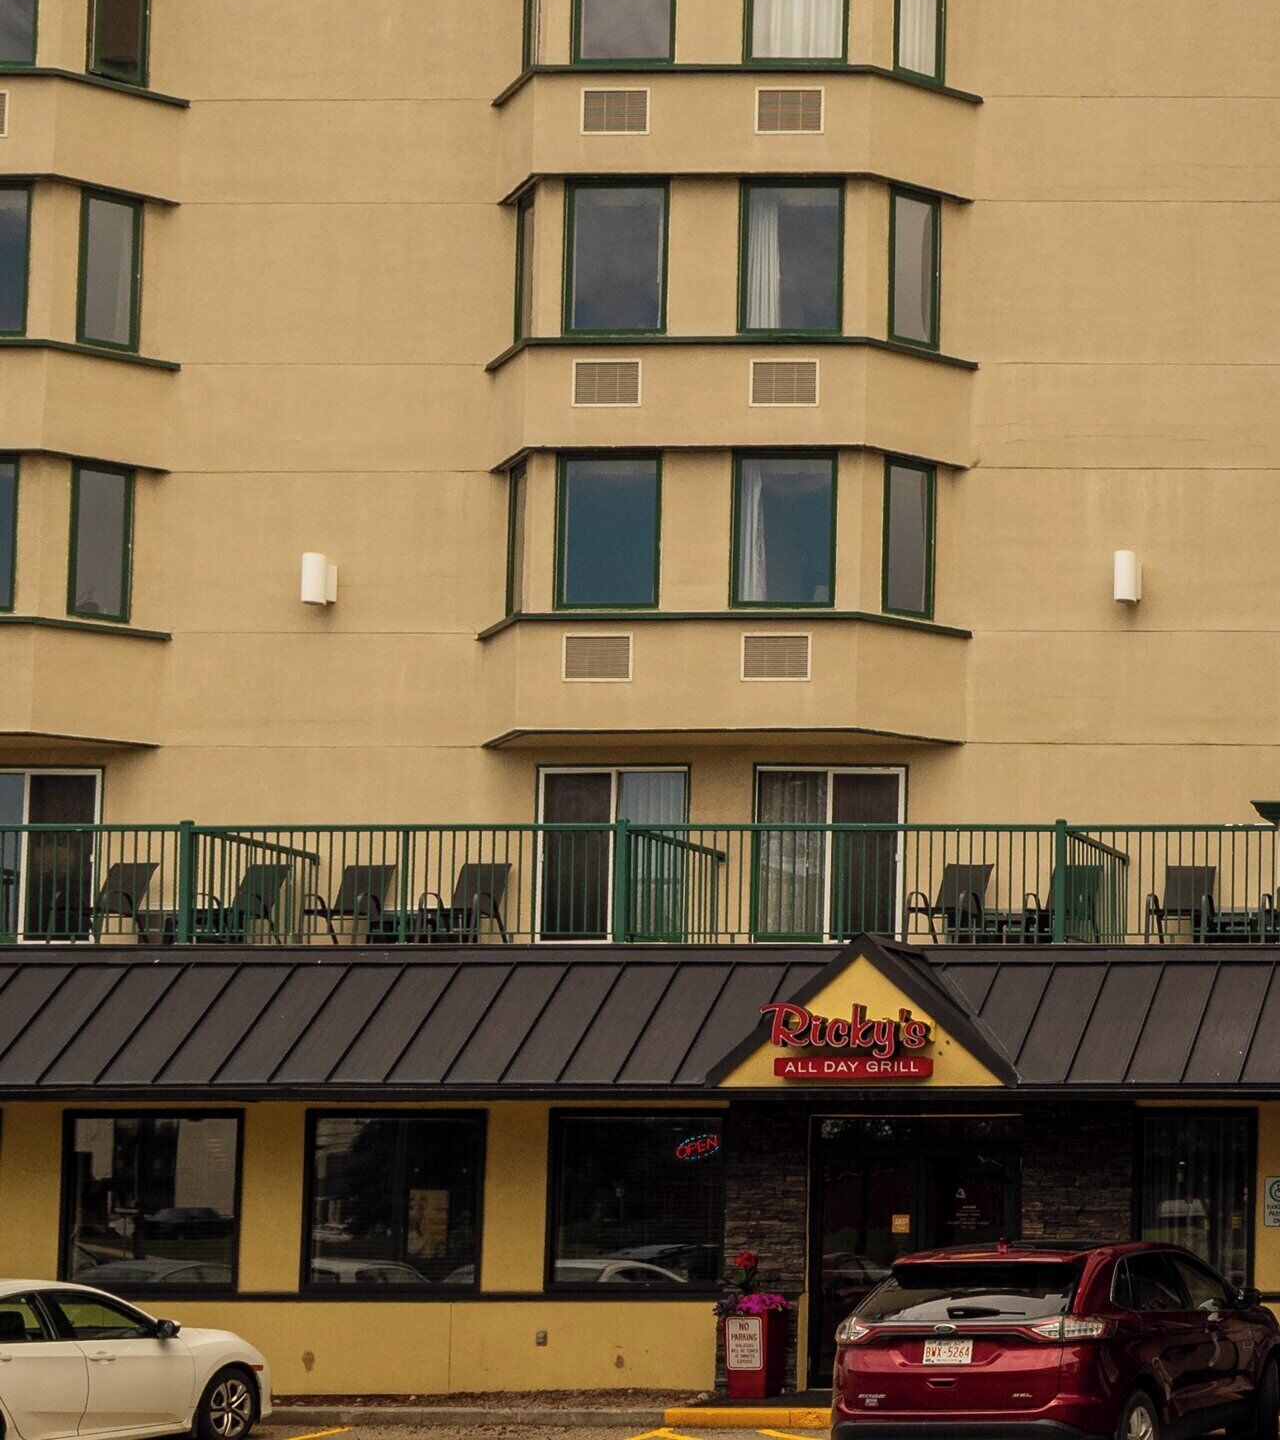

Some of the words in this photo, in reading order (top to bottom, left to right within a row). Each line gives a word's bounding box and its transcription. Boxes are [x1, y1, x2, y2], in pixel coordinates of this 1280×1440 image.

[759, 1003, 926, 1058] Ricky's
[785, 1061, 817, 1073] ALL
[824, 1061, 859, 1073] DAY
[866, 1060, 919, 1073] GRILL
[674, 1134, 719, 1160] OPEN
[739, 1322, 750, 1331] NO
[925, 1346, 970, 1358] BWX-5264
